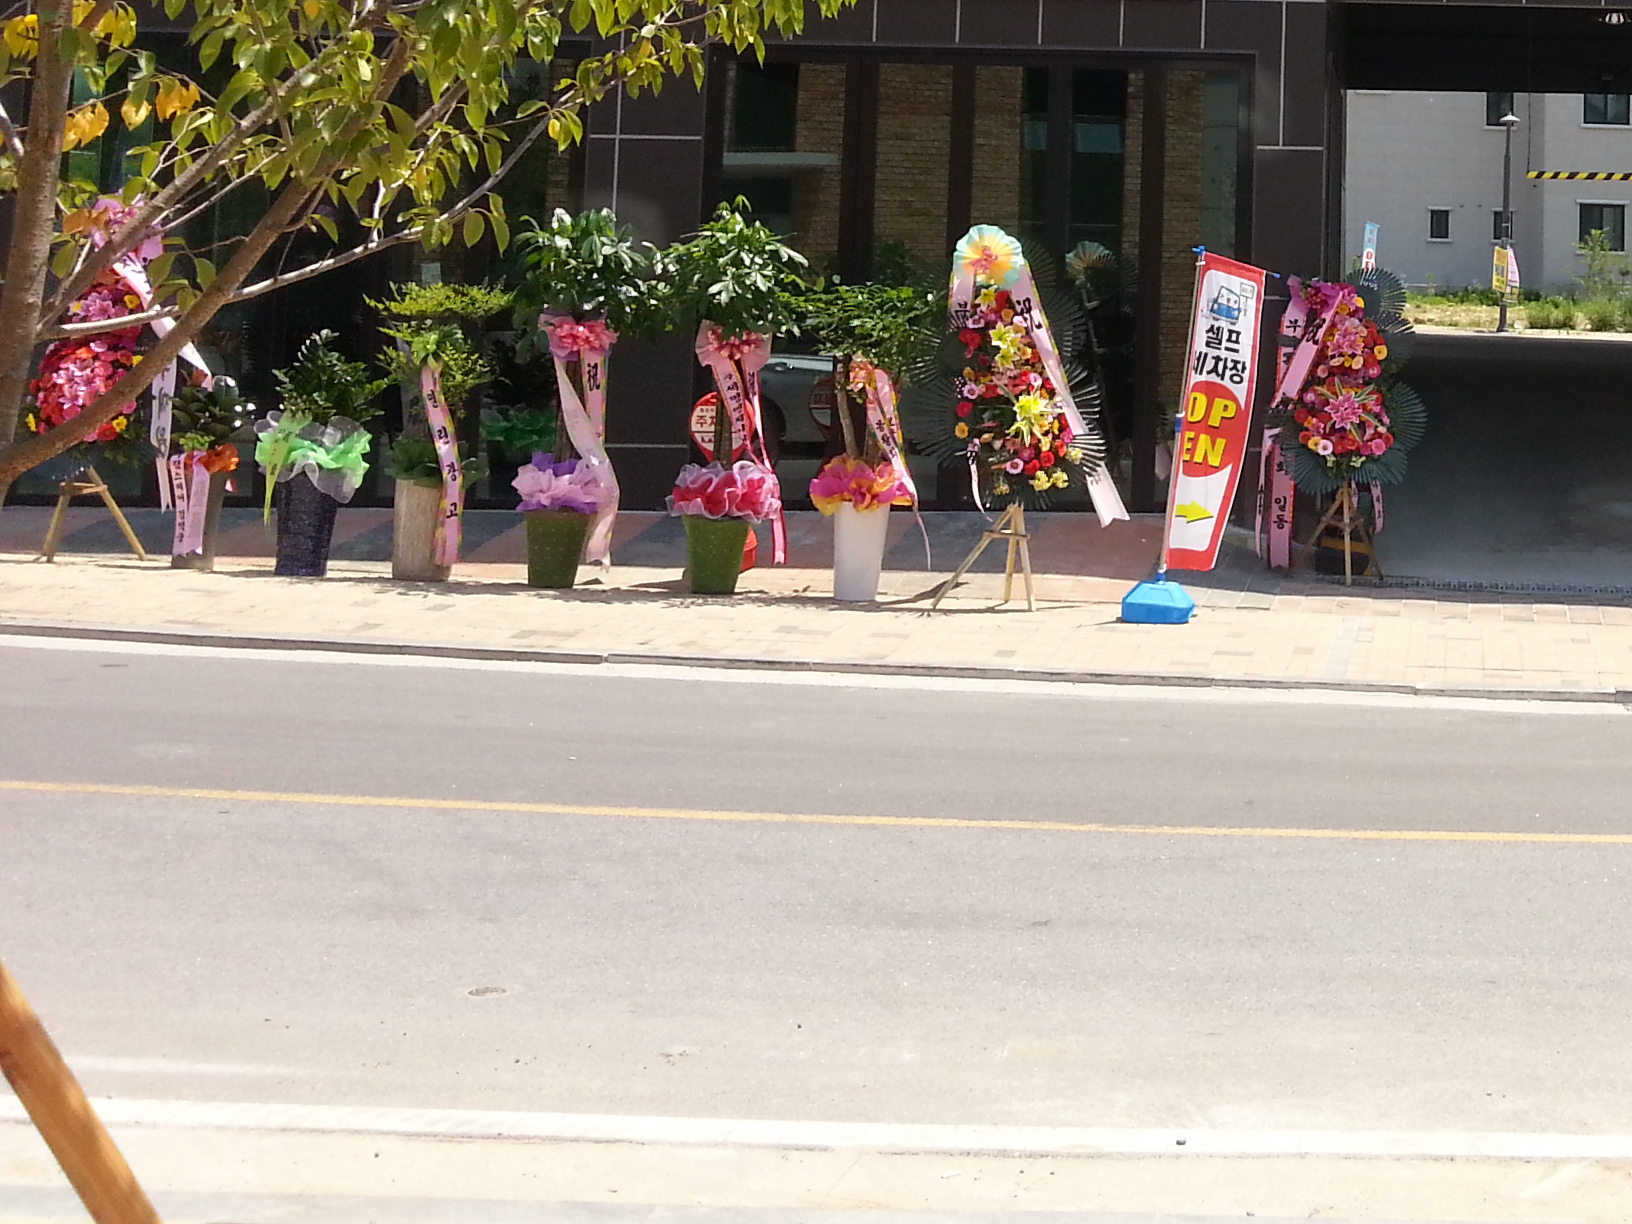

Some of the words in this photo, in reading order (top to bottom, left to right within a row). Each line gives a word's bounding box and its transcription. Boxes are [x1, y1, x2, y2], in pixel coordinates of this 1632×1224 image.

[1205, 324, 1241, 354] 셀프
[1187, 392, 1237, 435] OP
[1182, 431, 1227, 469] EN
